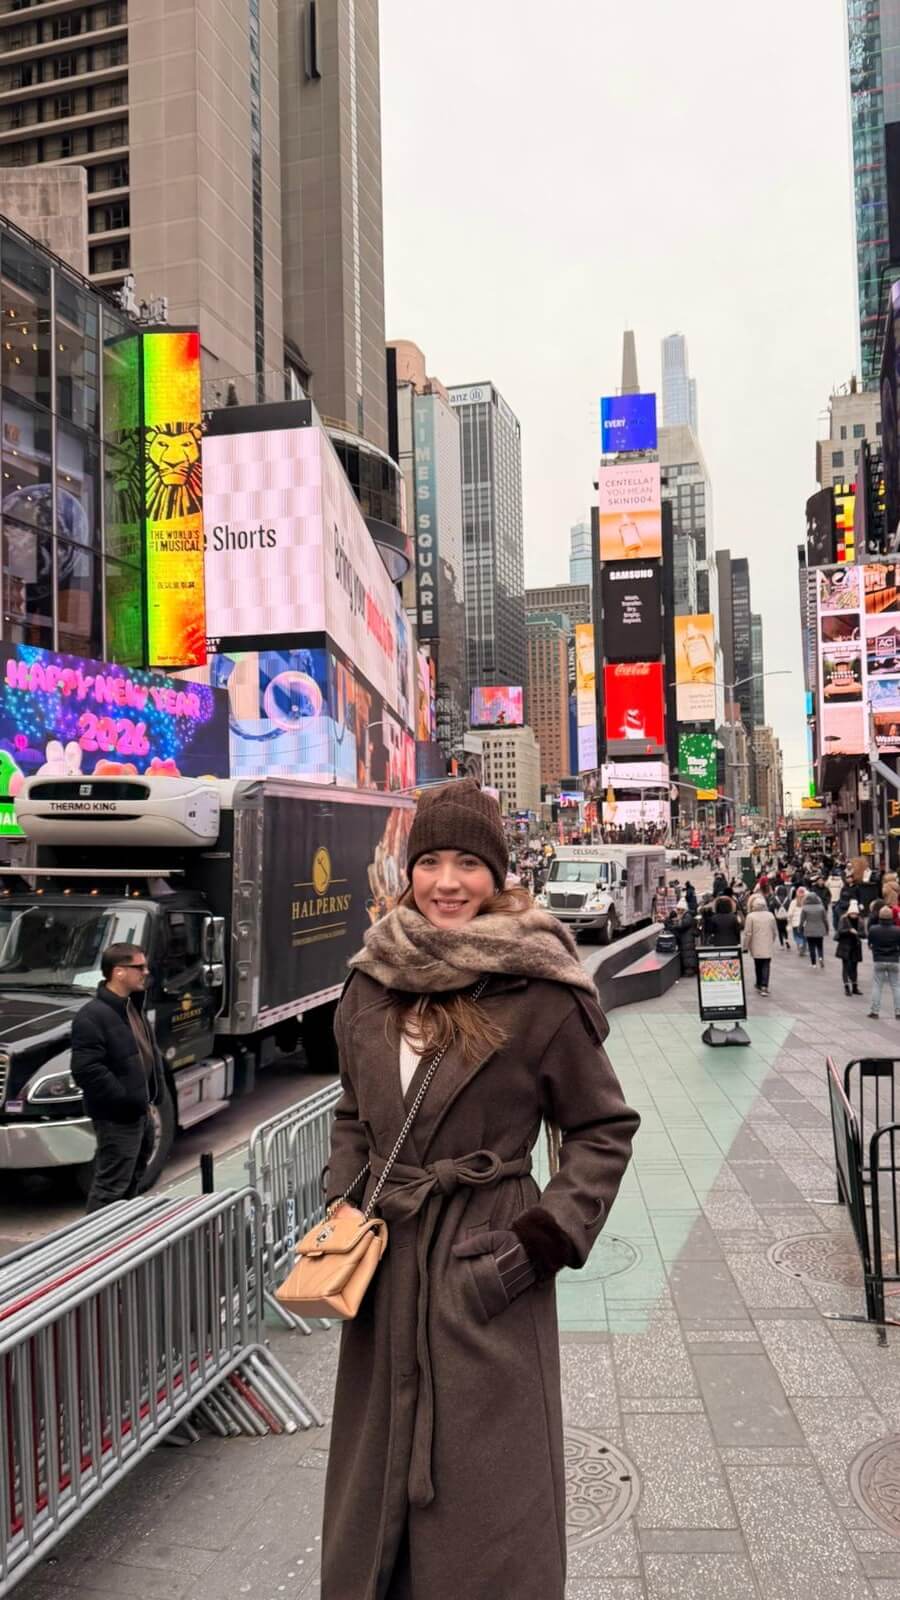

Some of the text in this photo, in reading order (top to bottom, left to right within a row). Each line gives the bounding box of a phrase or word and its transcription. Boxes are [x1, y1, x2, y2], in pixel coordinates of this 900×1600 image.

[416, 408, 434, 625] TIMES SQUARE
[150, 529, 164, 540] THE
[212, 525, 277, 552] Shorts
[160, 540, 200, 552] MUSICAL
[878, 638, 893, 648] AC
[5, 658, 201, 717] HAPPY NEW YEAR
[78, 712, 151, 756] 2026
[49, 802, 117, 811] THERMO KING
[572, 848, 599, 856] CELSIUS
